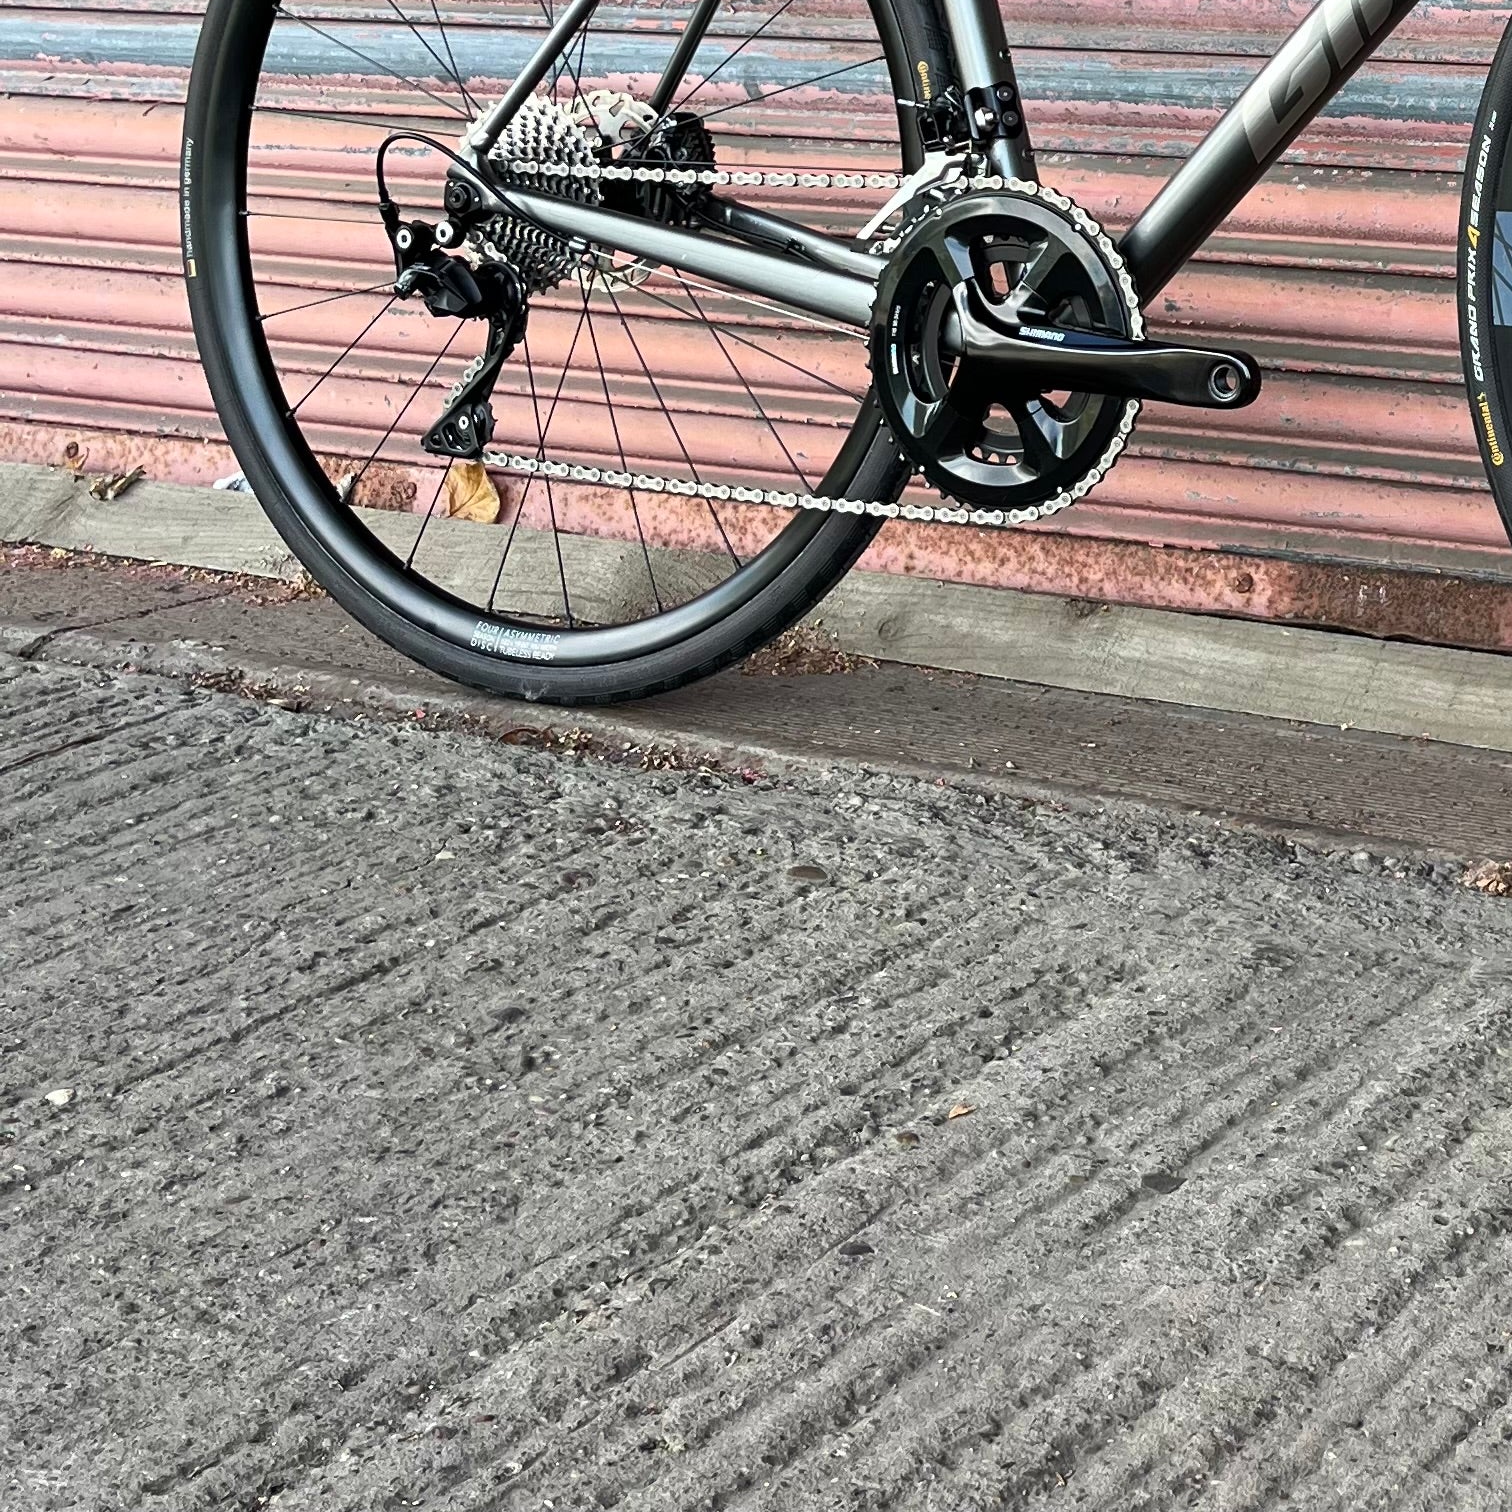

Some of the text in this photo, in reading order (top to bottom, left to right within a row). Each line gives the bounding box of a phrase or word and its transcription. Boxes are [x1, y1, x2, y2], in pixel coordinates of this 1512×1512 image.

[183, 137, 194, 258] handmade in germany
[1470, 134, 1492, 228] SEASON
[1467, 248, 1477, 302] PRIX
[1467, 304, 1485, 382] GRAND
[1478, 400, 1505, 466] Continental
[476, 620, 500, 635] FOUR
[503, 629, 561, 644] ASYMMETRIC
